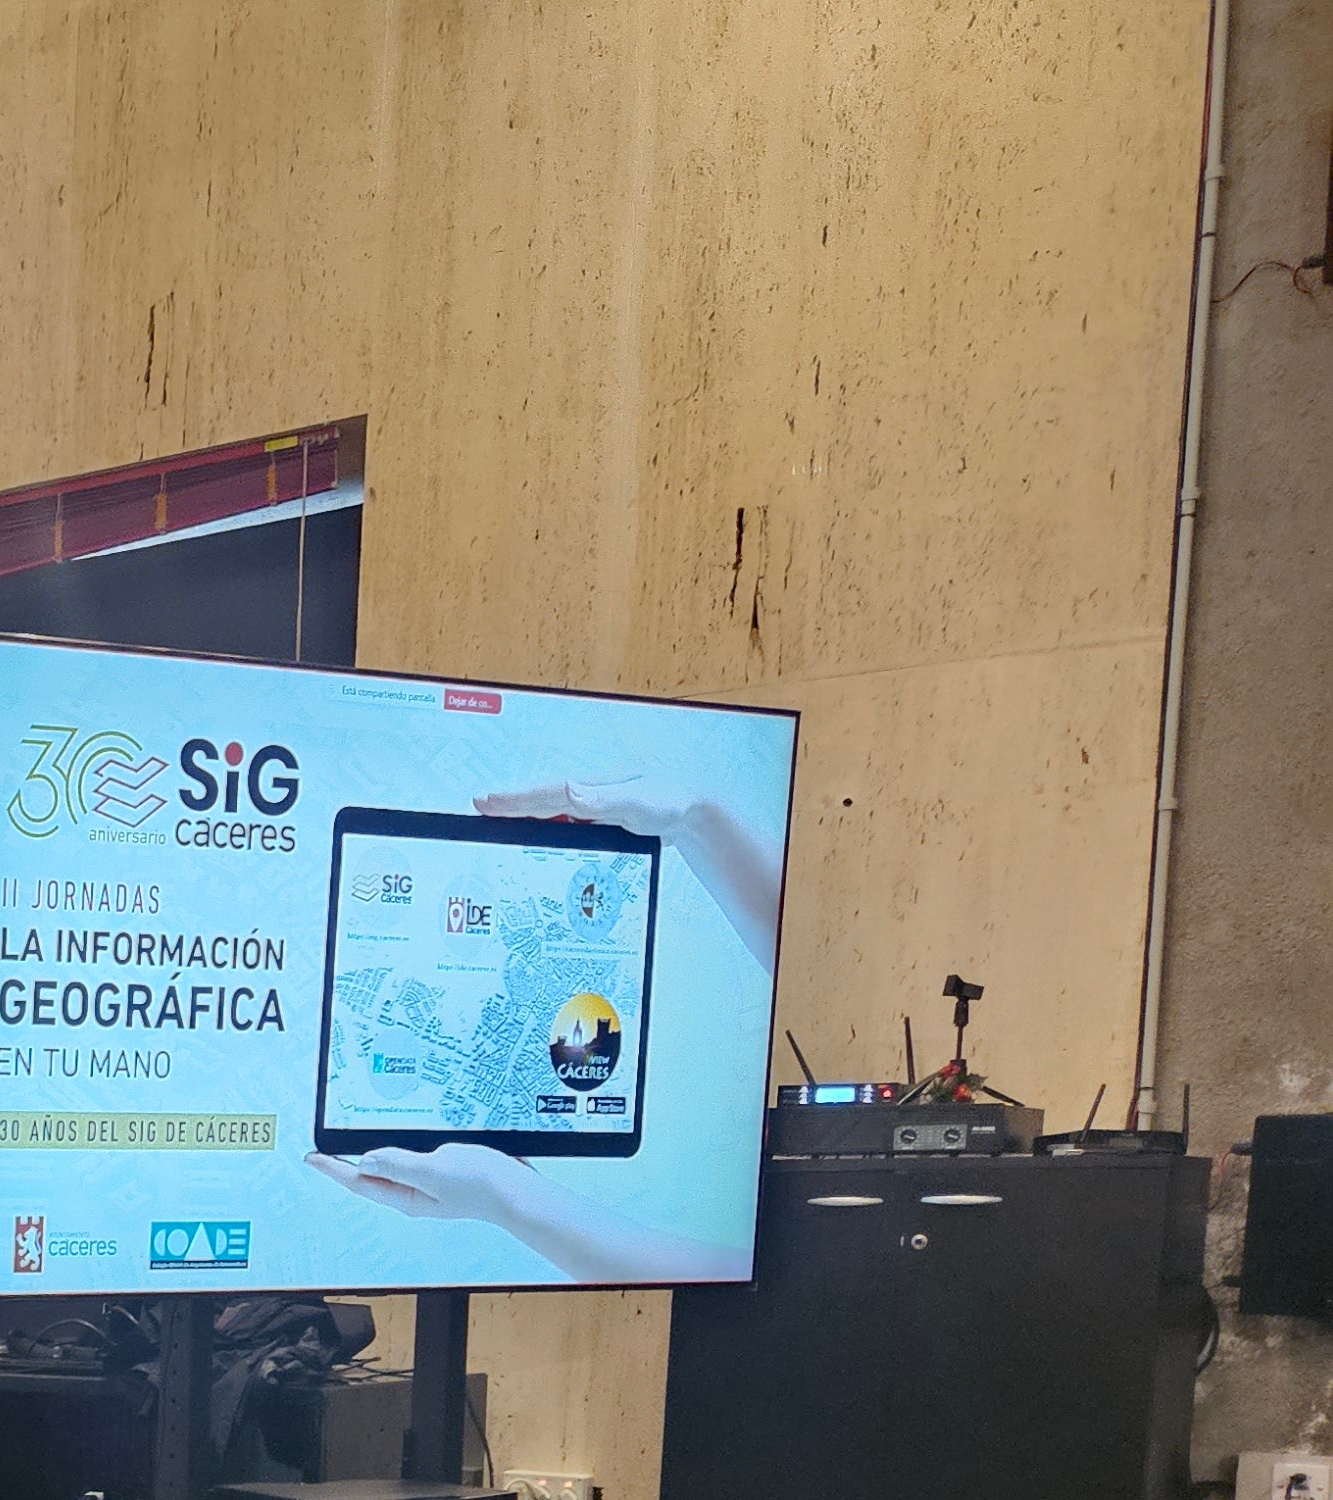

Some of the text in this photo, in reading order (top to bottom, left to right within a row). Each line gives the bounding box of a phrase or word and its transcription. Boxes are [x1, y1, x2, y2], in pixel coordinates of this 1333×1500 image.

[358, 687, 407, 700] compartiendo
[408, 693, 436, 703] pantalla
[448, 695, 467, 708] Dejar
[468, 698, 477, 707] de
[88, 825, 167, 845] aniversario
[2, 877, 161, 914] II JORNADAS
[0, 927, 285, 971] LA INFORMACIÓN
[0, 972, 286, 1032] GEOGRÁFICA
[43, 1048, 79, 1077] TU
[89, 1049, 171, 1079] MANO
[557, 1061, 609, 1080] CÁCERES
[29, 1114, 78, 1142] AÑOS
[87, 1120, 119, 1143] DEL
[128, 1120, 156, 1143] SIG
[166, 1121, 186, 1143] DE
[196, 1116, 271, 1144] CÁCERES
